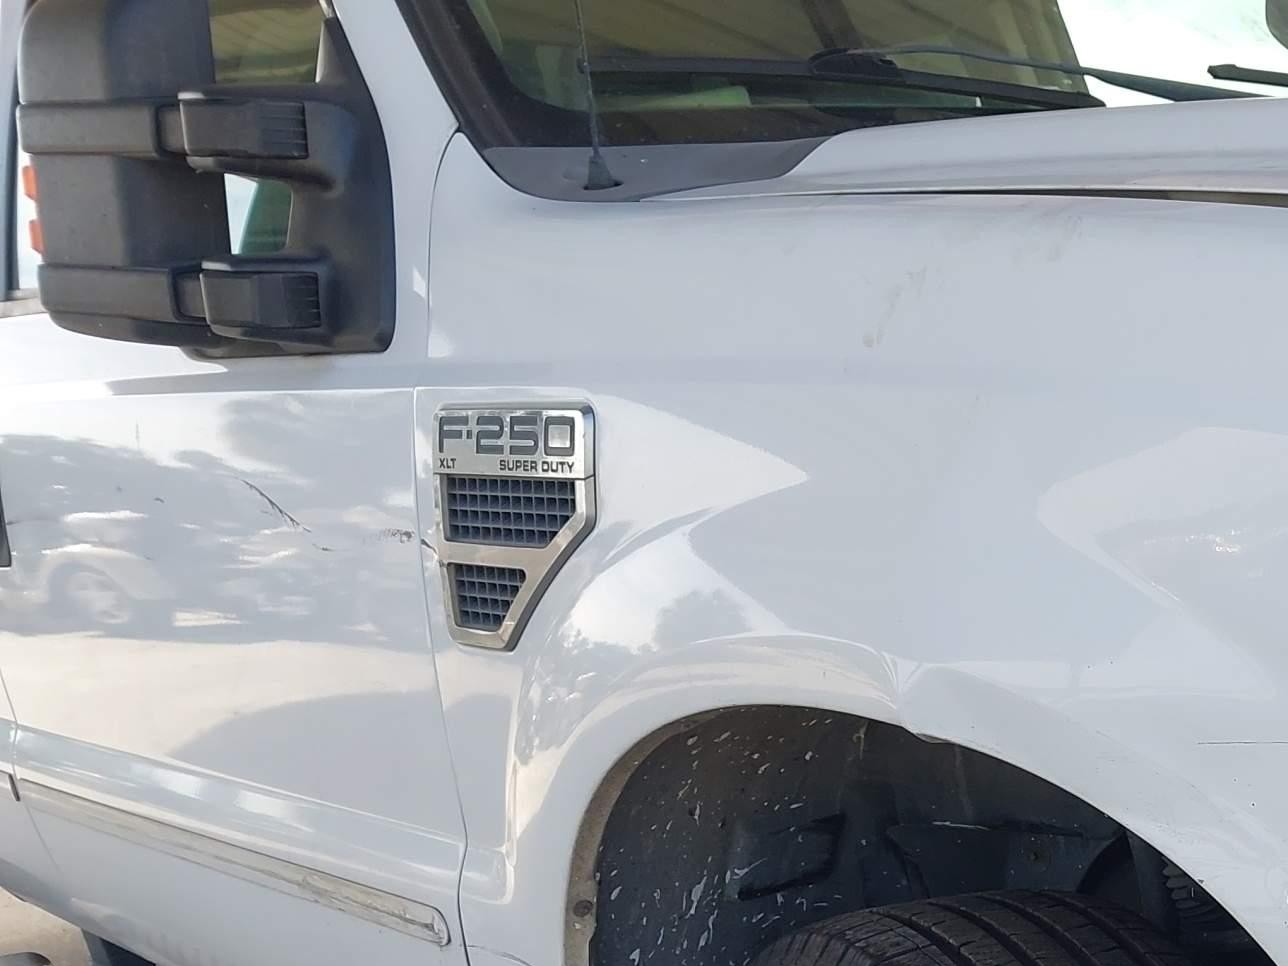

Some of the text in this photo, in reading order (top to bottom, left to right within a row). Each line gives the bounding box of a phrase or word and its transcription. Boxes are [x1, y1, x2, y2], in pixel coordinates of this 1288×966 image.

[438, 415, 576, 457] F-250
[439, 458, 457, 470] XLT
[499, 459, 575, 474] SUPER DUTY
